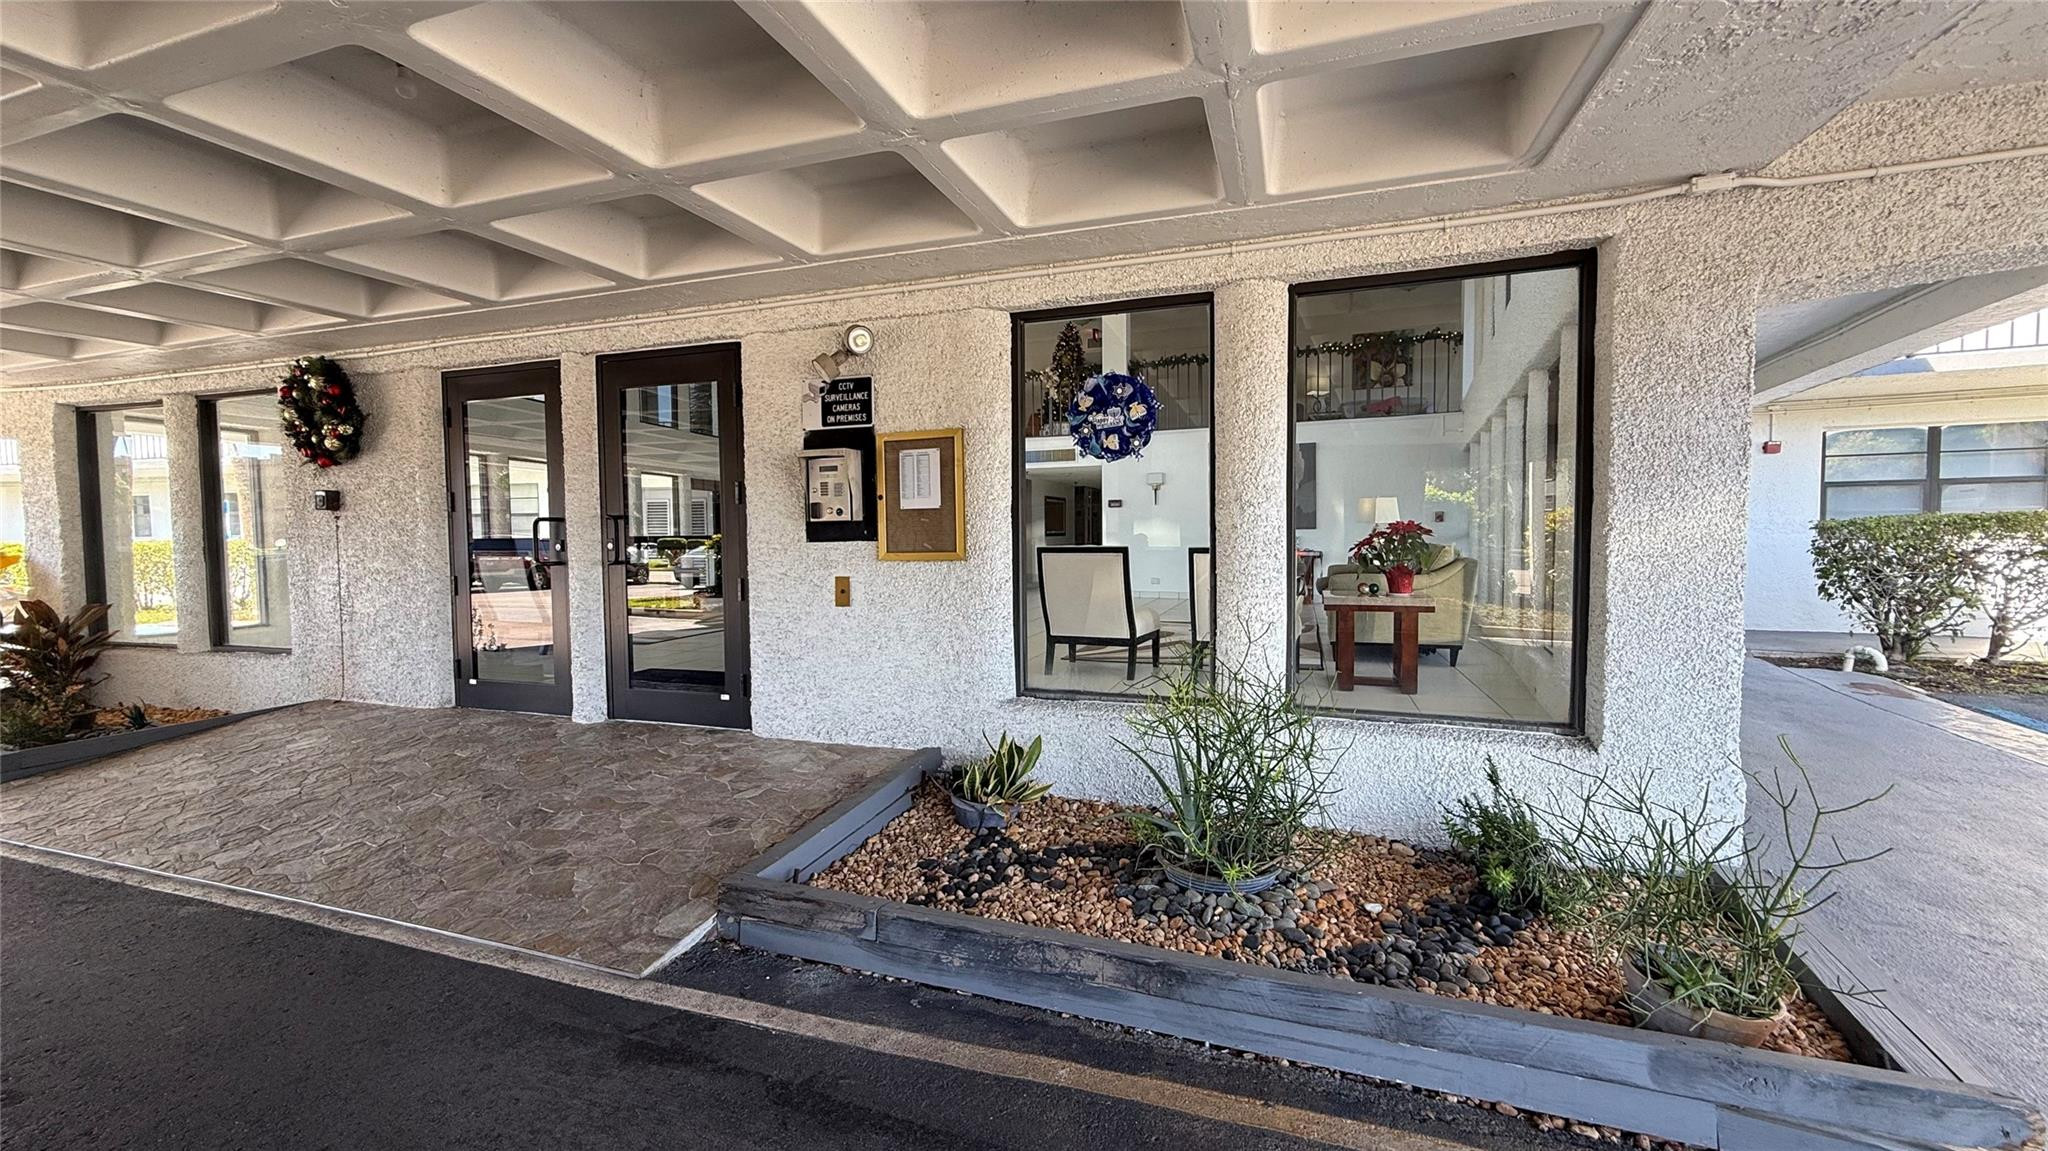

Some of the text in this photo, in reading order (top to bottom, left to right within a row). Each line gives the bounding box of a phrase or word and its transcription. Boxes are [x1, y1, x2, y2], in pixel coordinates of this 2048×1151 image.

[838, 382, 854, 391] CCTV
[824, 391, 869, 402] SURVEILLANCE
[832, 402, 861, 412] CAMERAS
[826, 413, 867, 423] ON PREMISES
